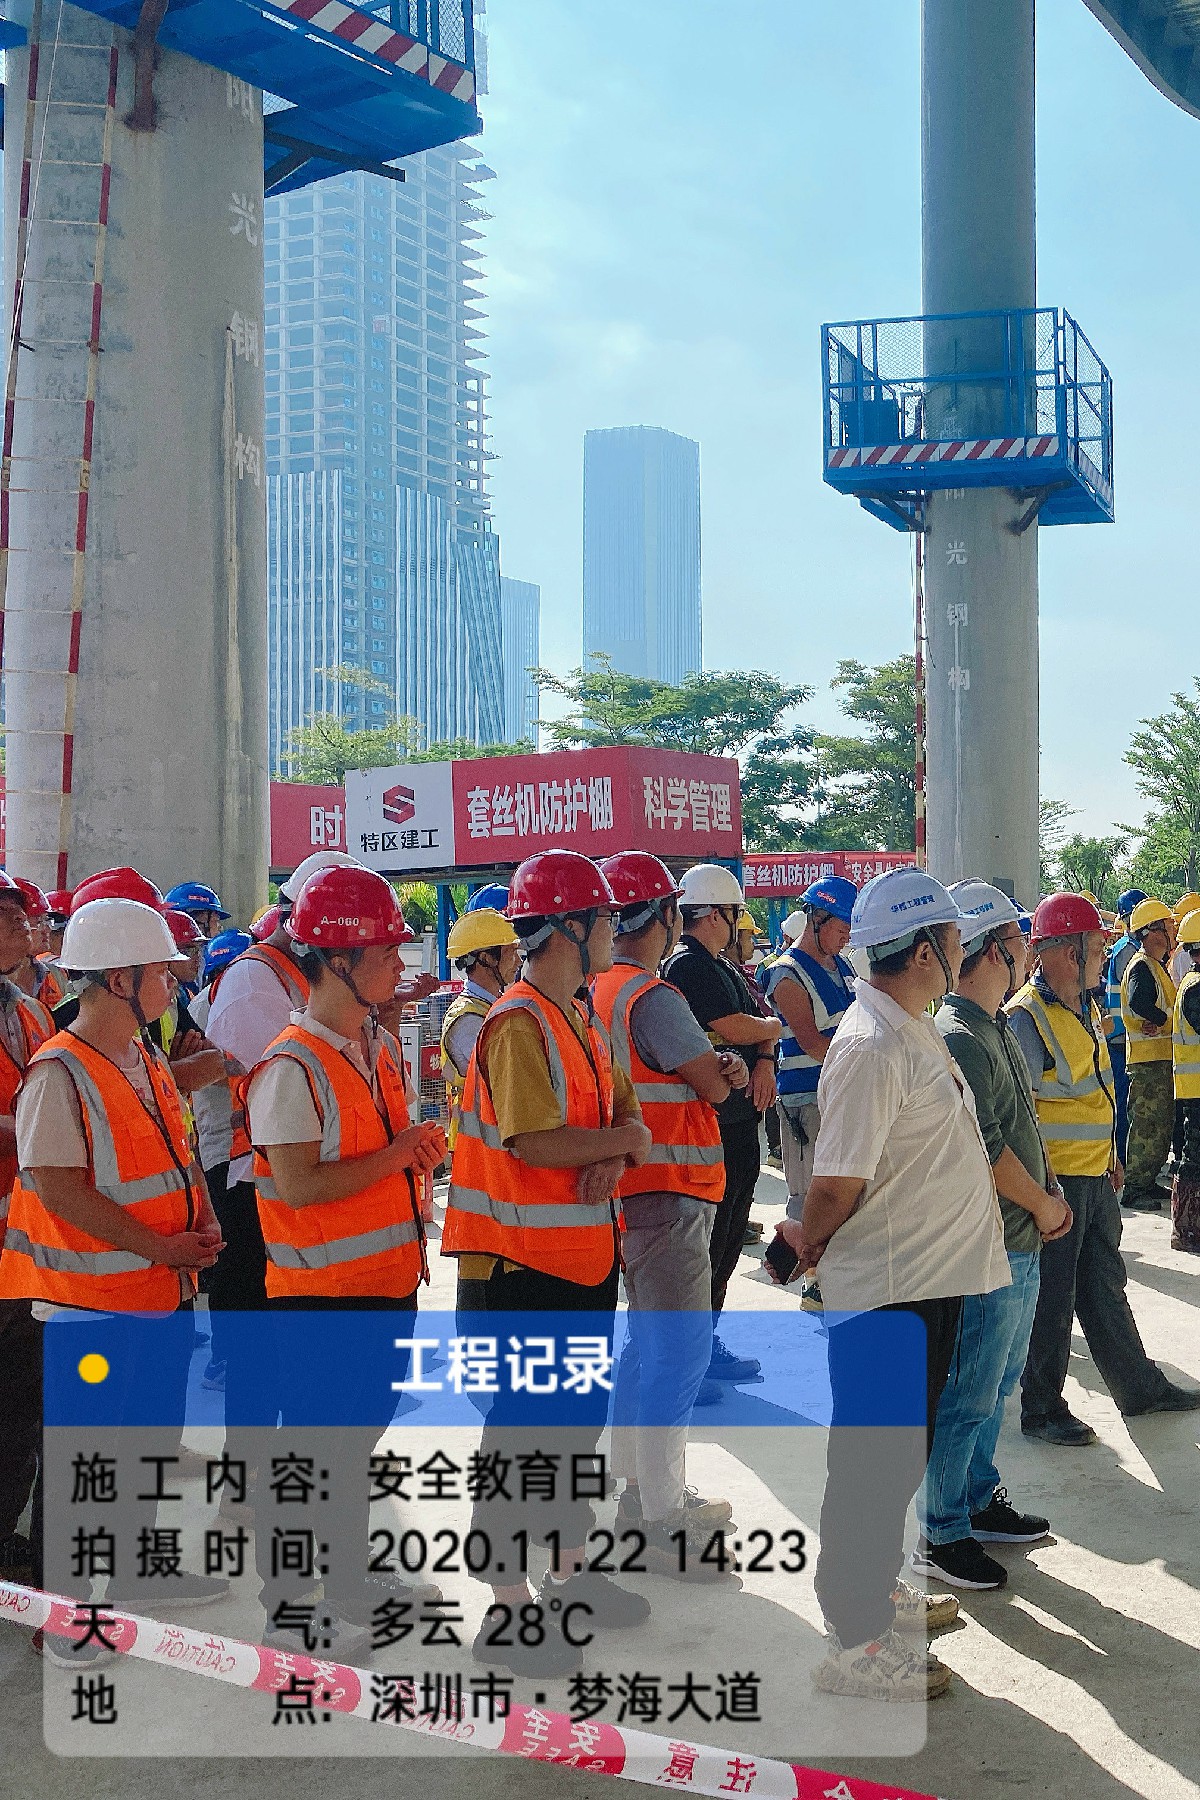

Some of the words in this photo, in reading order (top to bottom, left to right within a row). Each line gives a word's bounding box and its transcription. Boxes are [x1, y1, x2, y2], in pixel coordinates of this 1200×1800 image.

[467, 776, 614, 838] 套丝机防护棚
[642, 776, 733, 832] 科学管理
[310, 805, 343, 847] 时
[360, 829, 439, 852] 特区建工
[321, 916, 359, 927] A-060
